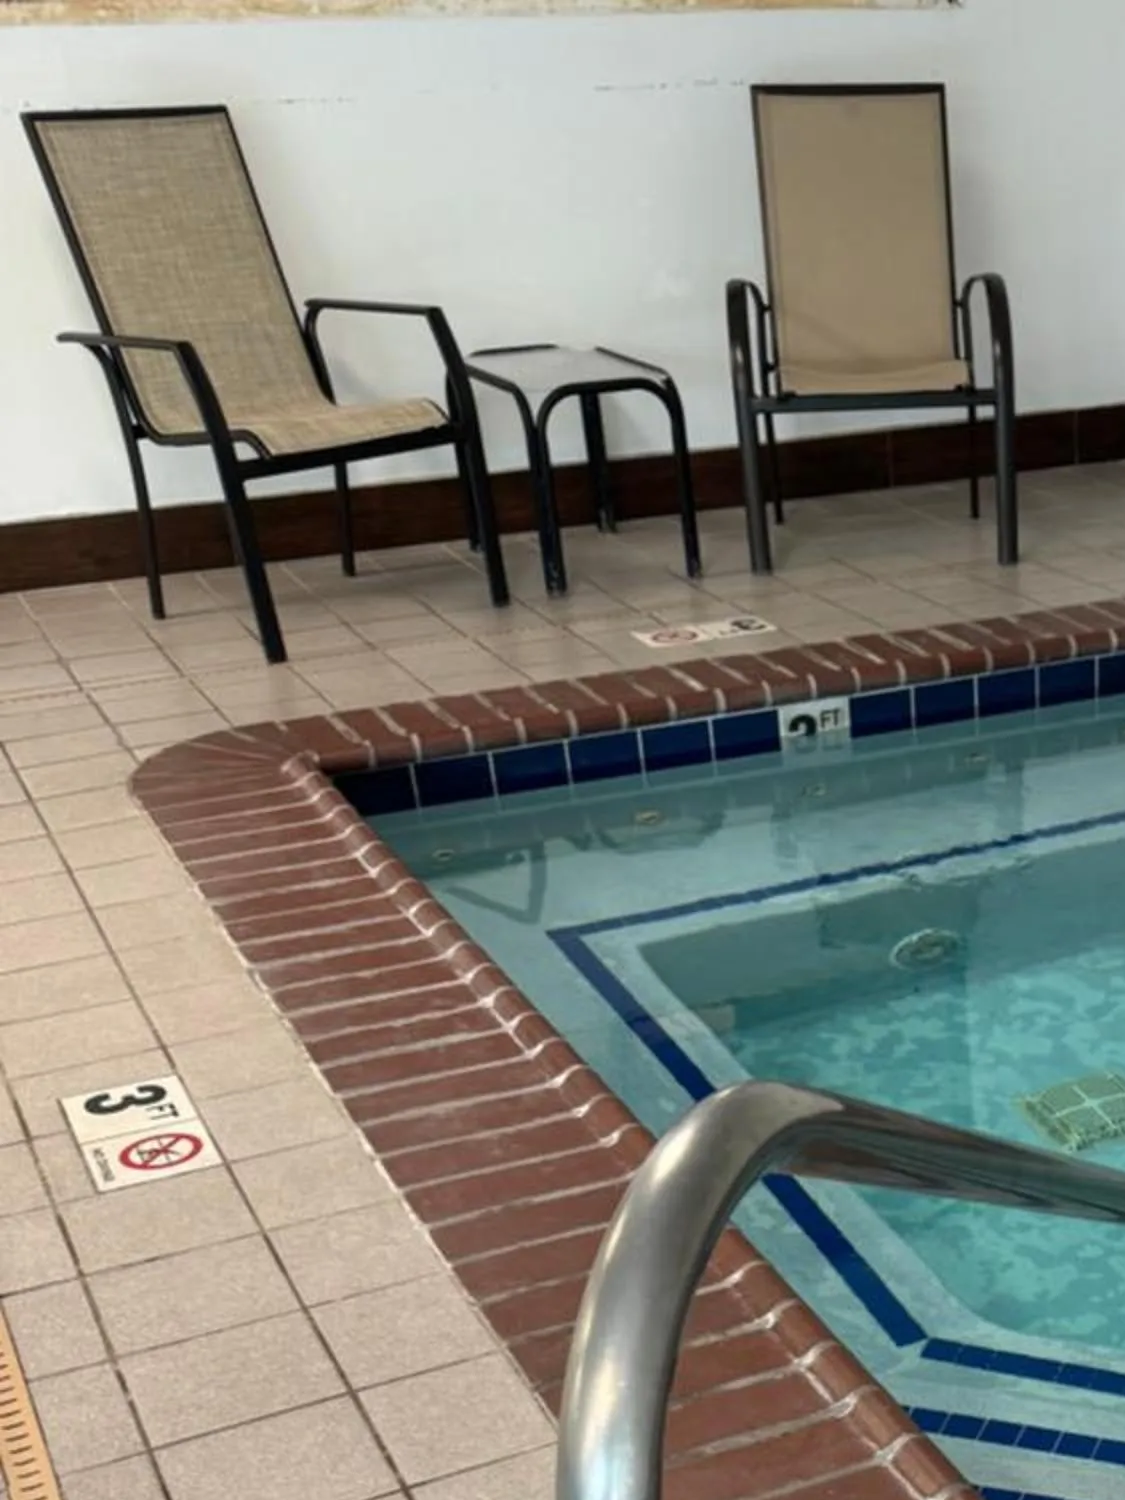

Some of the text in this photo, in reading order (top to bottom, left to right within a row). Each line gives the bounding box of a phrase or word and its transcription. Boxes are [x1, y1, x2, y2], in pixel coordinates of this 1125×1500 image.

[820, 707, 841, 729] FT
[84, 1084, 180, 1121] 3 FT
